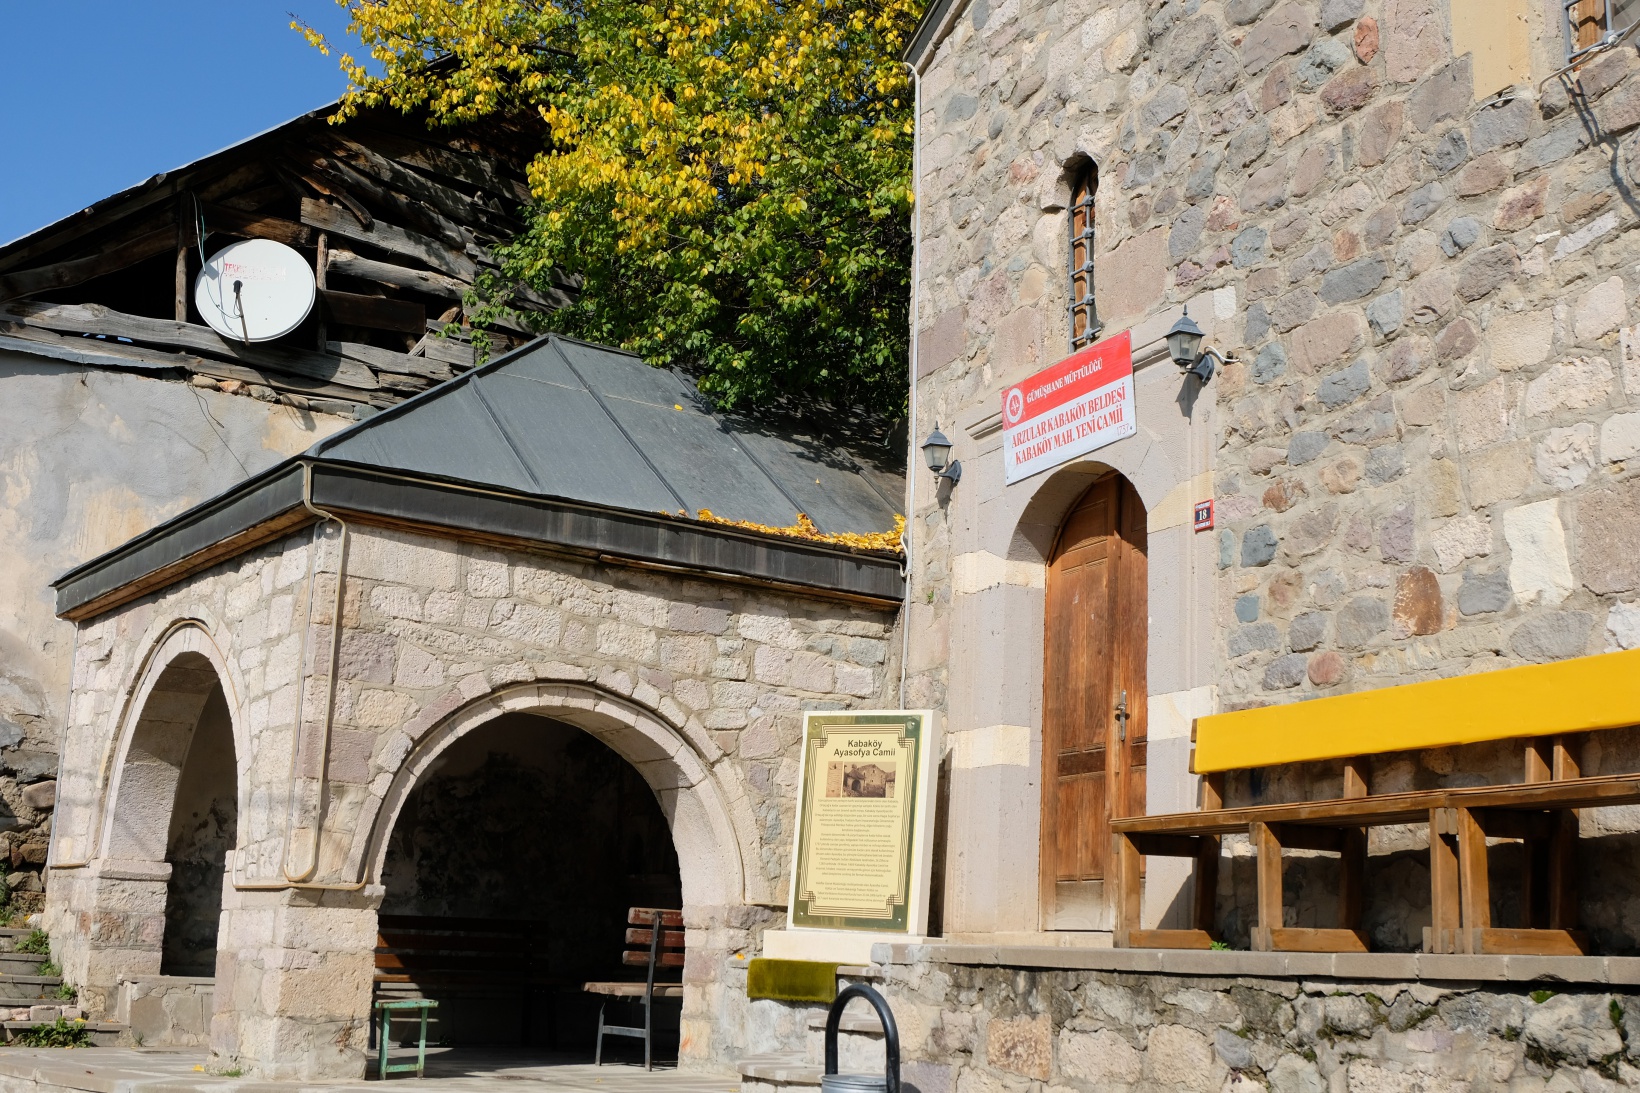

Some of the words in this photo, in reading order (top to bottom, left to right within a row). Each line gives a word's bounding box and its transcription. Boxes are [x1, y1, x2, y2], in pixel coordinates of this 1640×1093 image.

[1026, 377, 1063, 403] GÜMÜŞHANE
[1064, 356, 1103, 386] MÜFTÜLÜĞÜ
[1012, 421, 1047, 448] ARZULAR
[1047, 402, 1086, 432] KABAKÖY
[1088, 382, 1126, 415] BELDESİ
[1015, 436, 1053, 465] KABAKÖY
[1053, 428, 1075, 449] MAH.
[1076, 415, 1096, 439] YENİ
[1097, 403, 1124, 431] CAMİİ
[1198, 508, 1208, 521] 18
[833, 748, 871, 758] Ayasofya
[872, 748, 896, 757] Camii
[847, 739, 883, 750] Kabaköy
